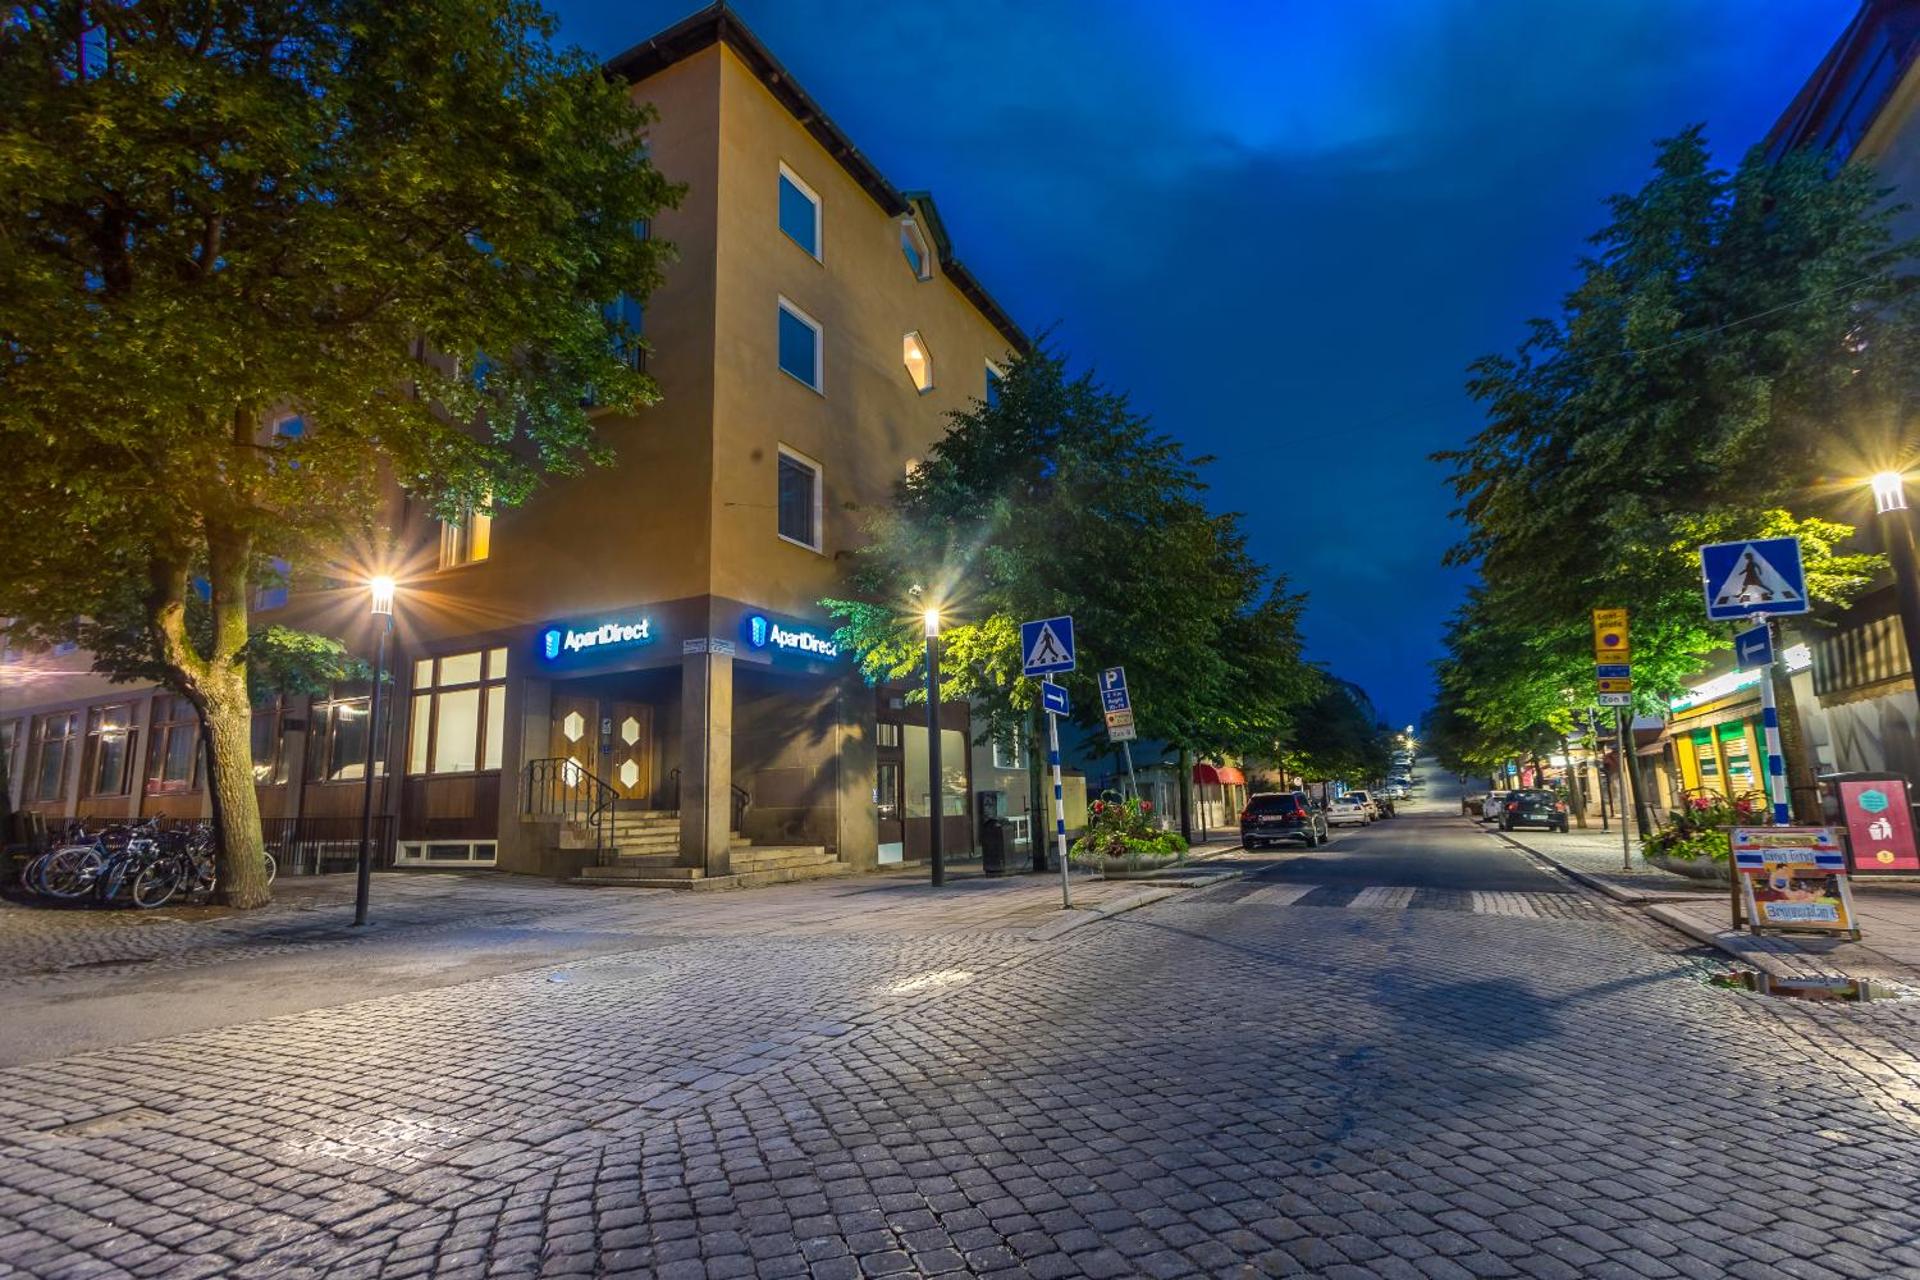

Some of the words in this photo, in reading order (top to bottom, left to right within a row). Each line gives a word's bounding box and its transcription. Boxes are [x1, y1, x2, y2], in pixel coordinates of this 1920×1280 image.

[564, 619, 649, 652] ApartDirect
[1106, 671, 1117, 689] P
[1600, 695, 1620, 704] Zon
